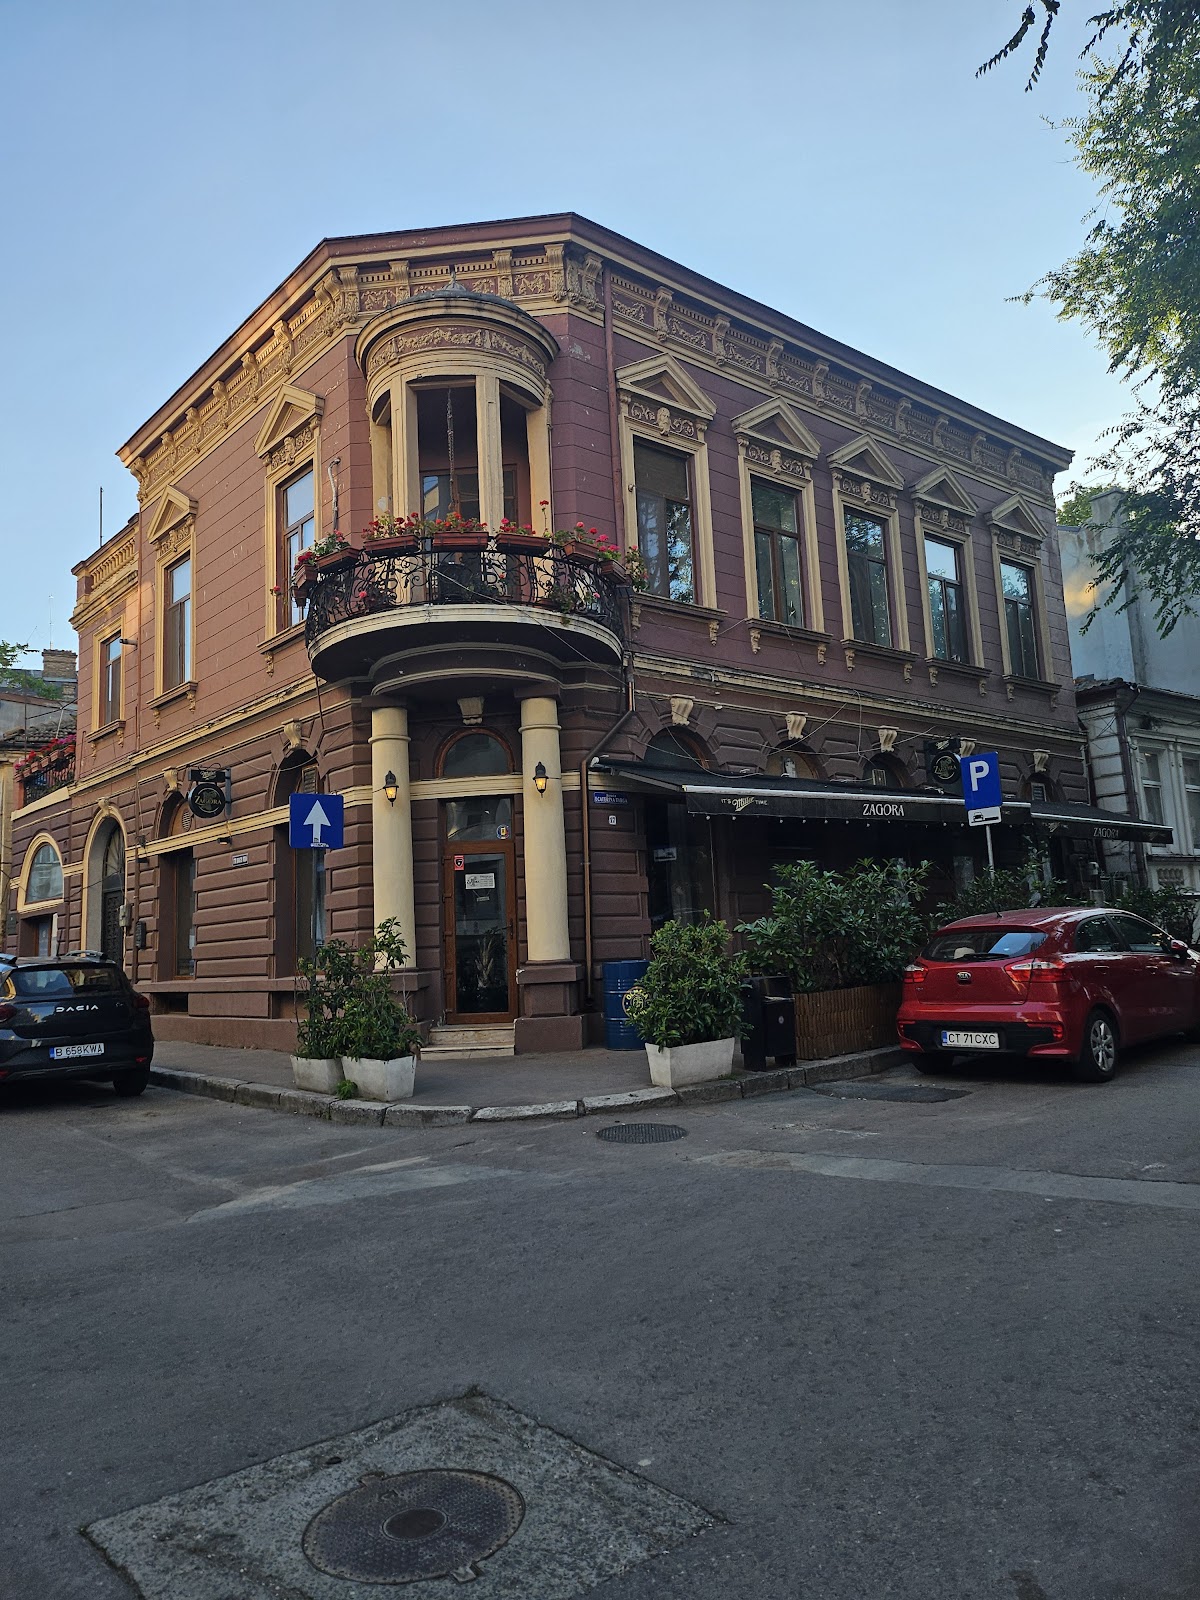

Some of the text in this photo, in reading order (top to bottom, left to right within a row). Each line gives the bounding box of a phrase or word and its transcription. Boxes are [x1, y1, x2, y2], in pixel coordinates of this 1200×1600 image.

[970, 760, 990, 792] P
[862, 803, 905, 817] ZAGORA
[1093, 827, 1119, 839] ZAGORA
[56, 1005, 99, 1013] DACIA
[948, 1033, 960, 1043] CT
[56, 1048, 63, 1057] B
